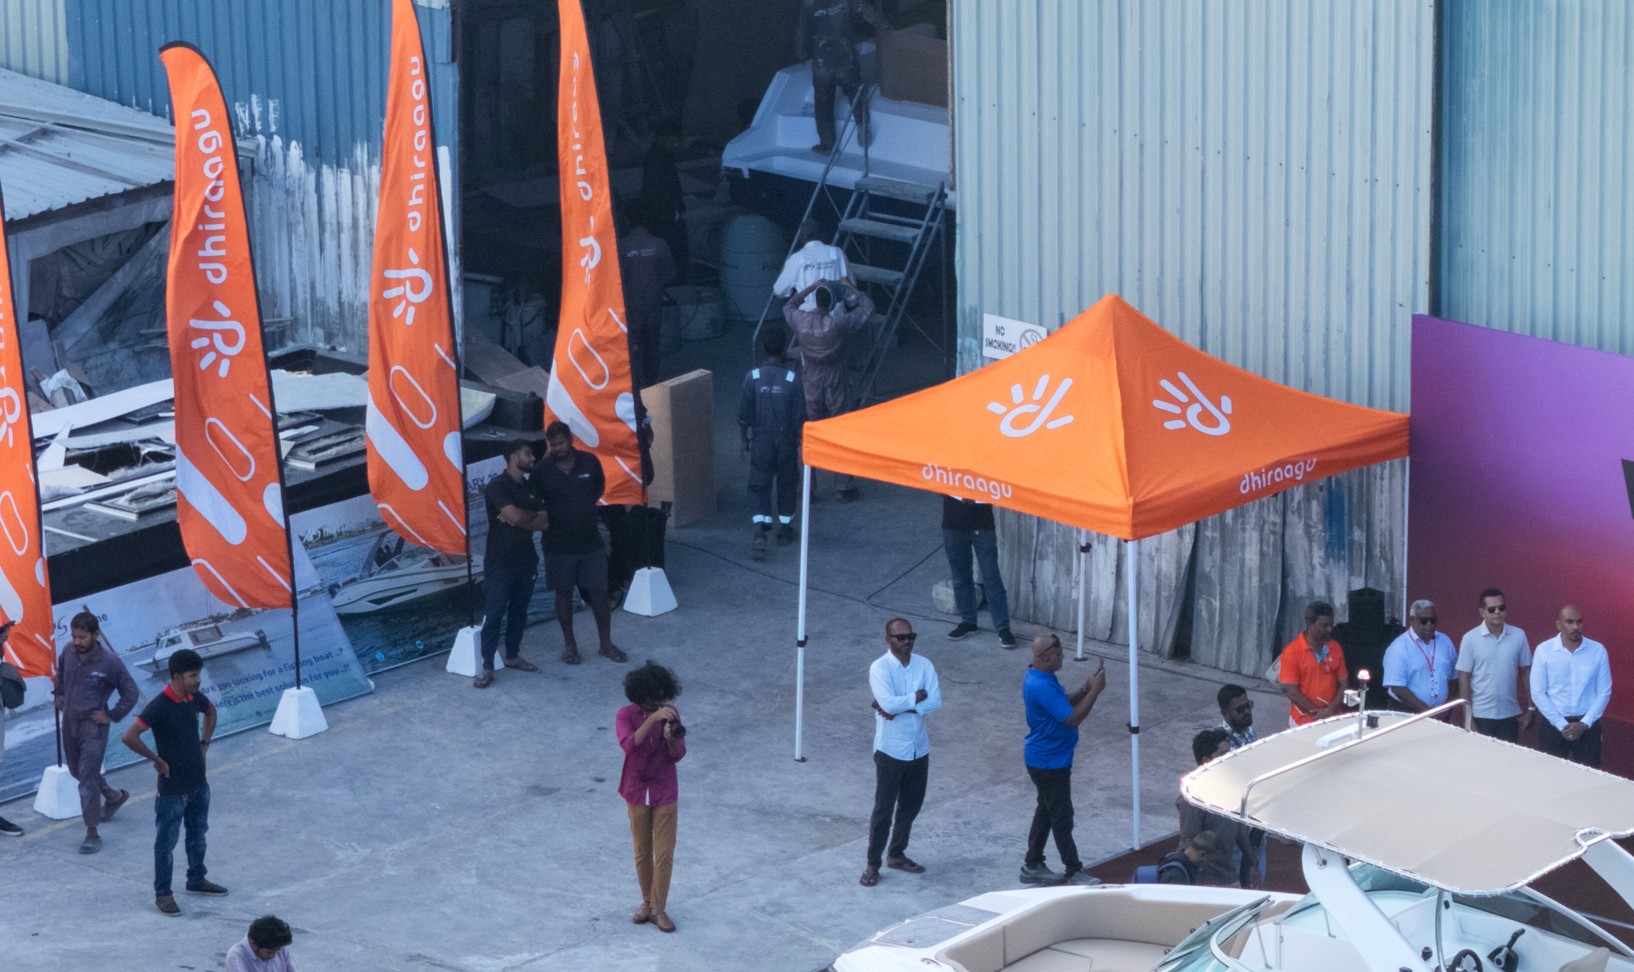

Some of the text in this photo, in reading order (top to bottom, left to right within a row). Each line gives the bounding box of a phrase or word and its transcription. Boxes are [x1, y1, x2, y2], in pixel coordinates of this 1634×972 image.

[408, 56, 426, 232] dhiraagu
[191, 108, 228, 285] dhiraagu
[995, 325, 1005, 336] NO
[922, 462, 1012, 500] dhiraagu
[1240, 458, 1316, 494] dhiraagu
[313, 651, 334, 663] boat
